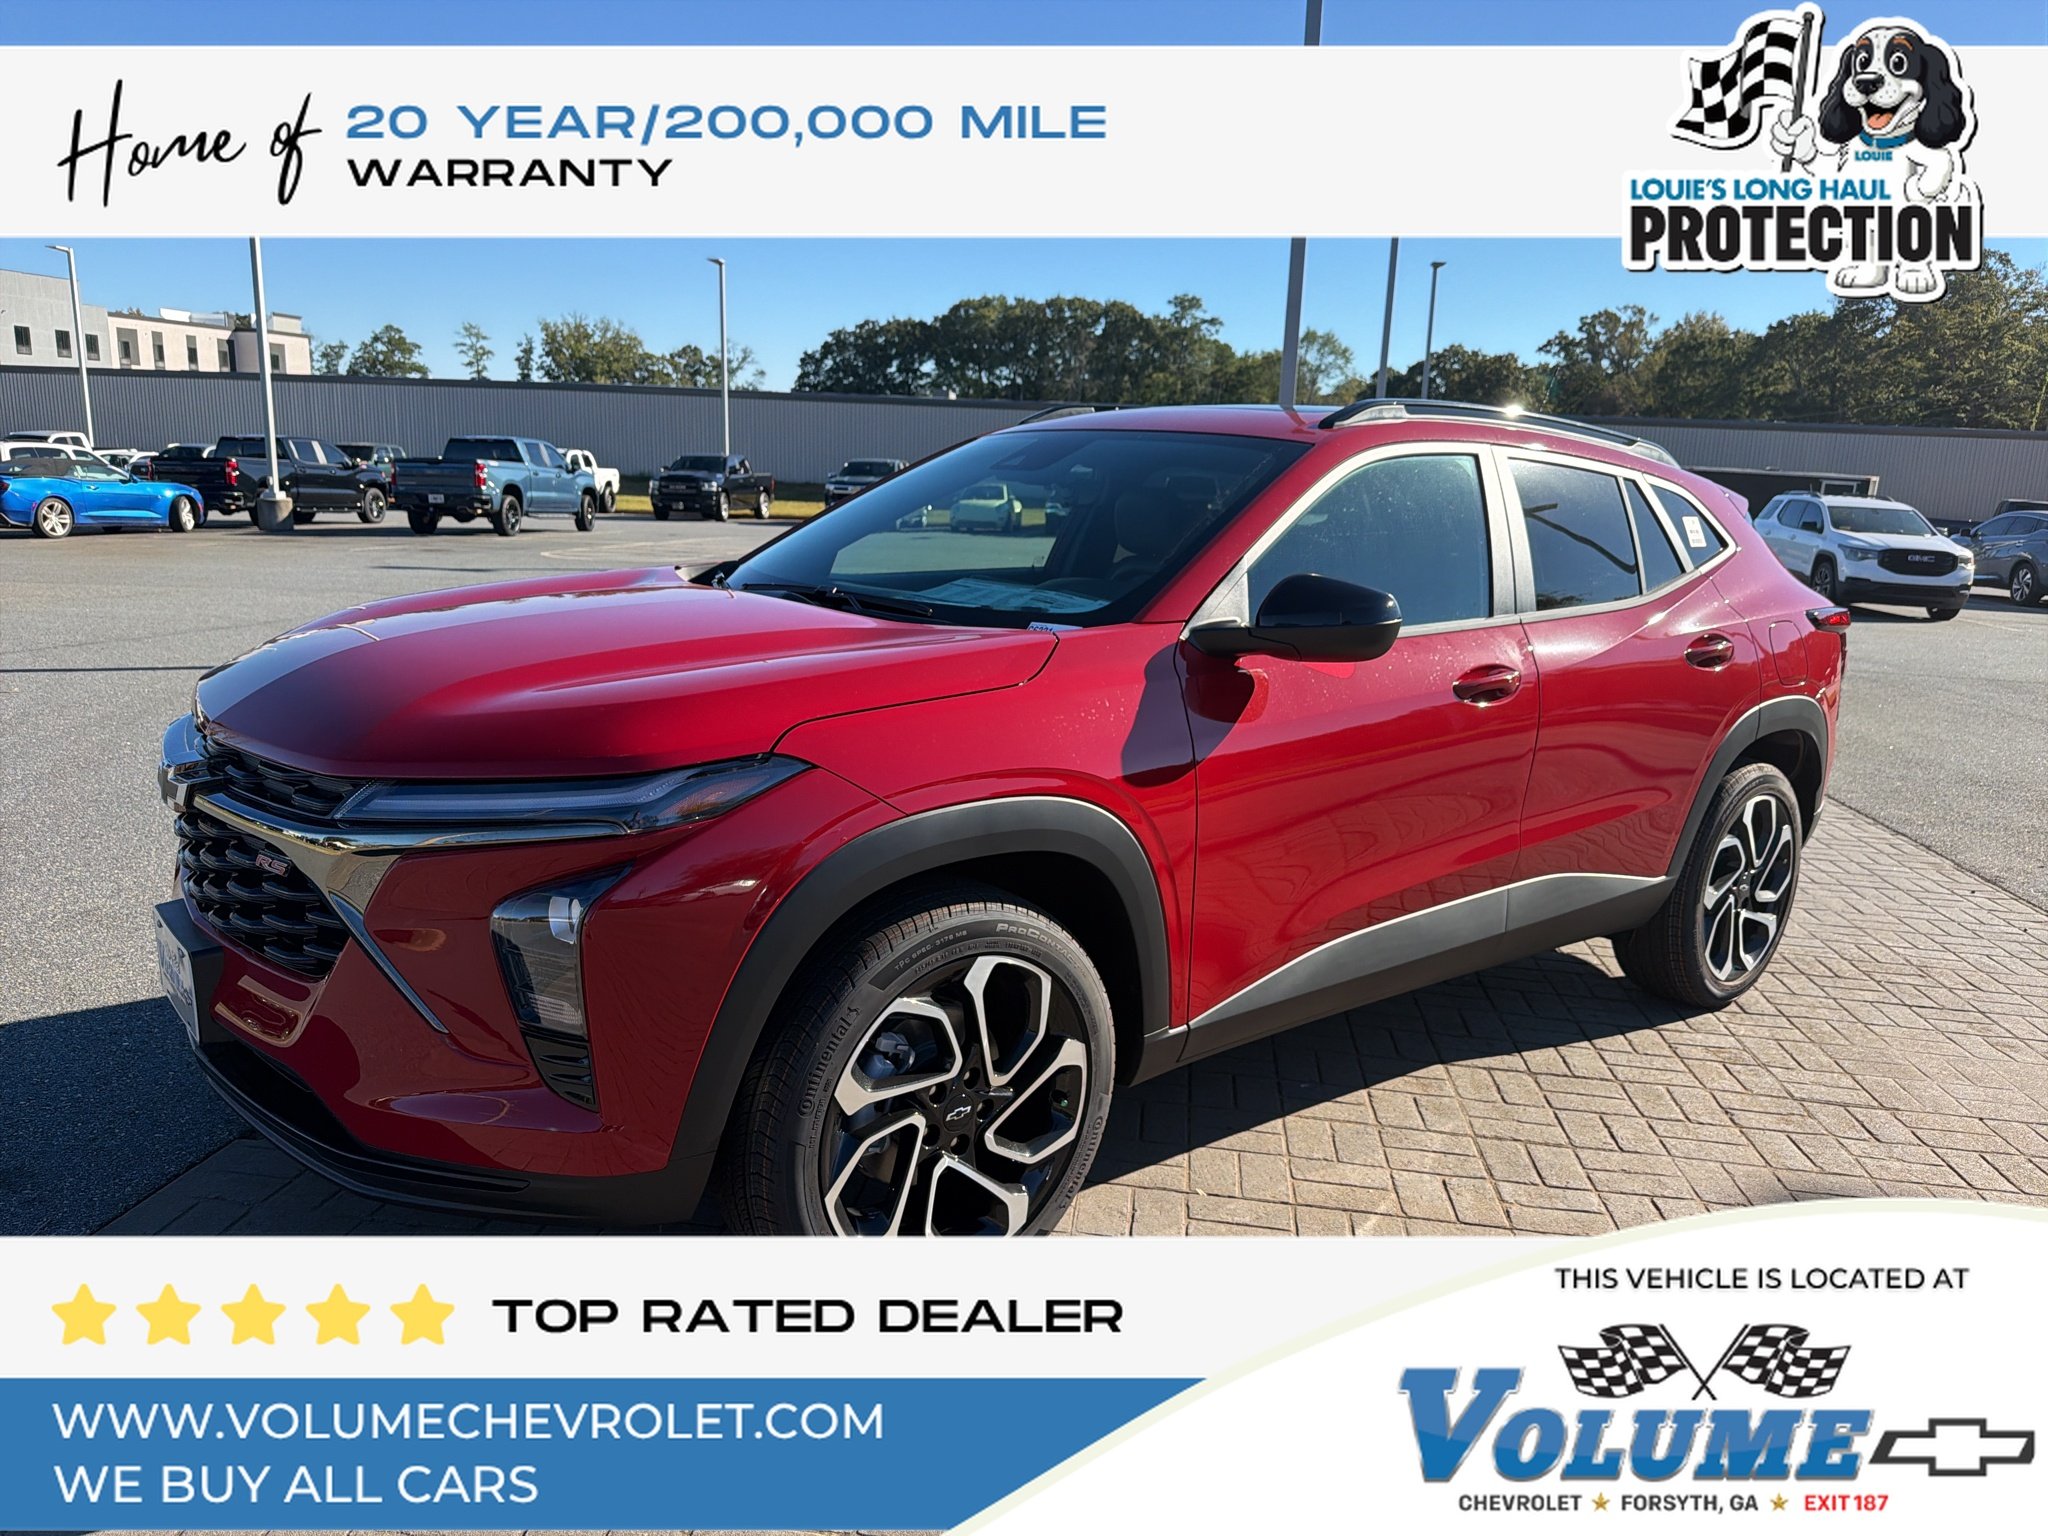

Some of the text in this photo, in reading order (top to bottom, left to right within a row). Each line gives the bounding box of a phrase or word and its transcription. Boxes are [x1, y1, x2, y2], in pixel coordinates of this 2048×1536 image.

[1907, 554, 1936, 562] GMC
[256, 854, 288, 877] RS
[798, 1015, 852, 1118] Continental
